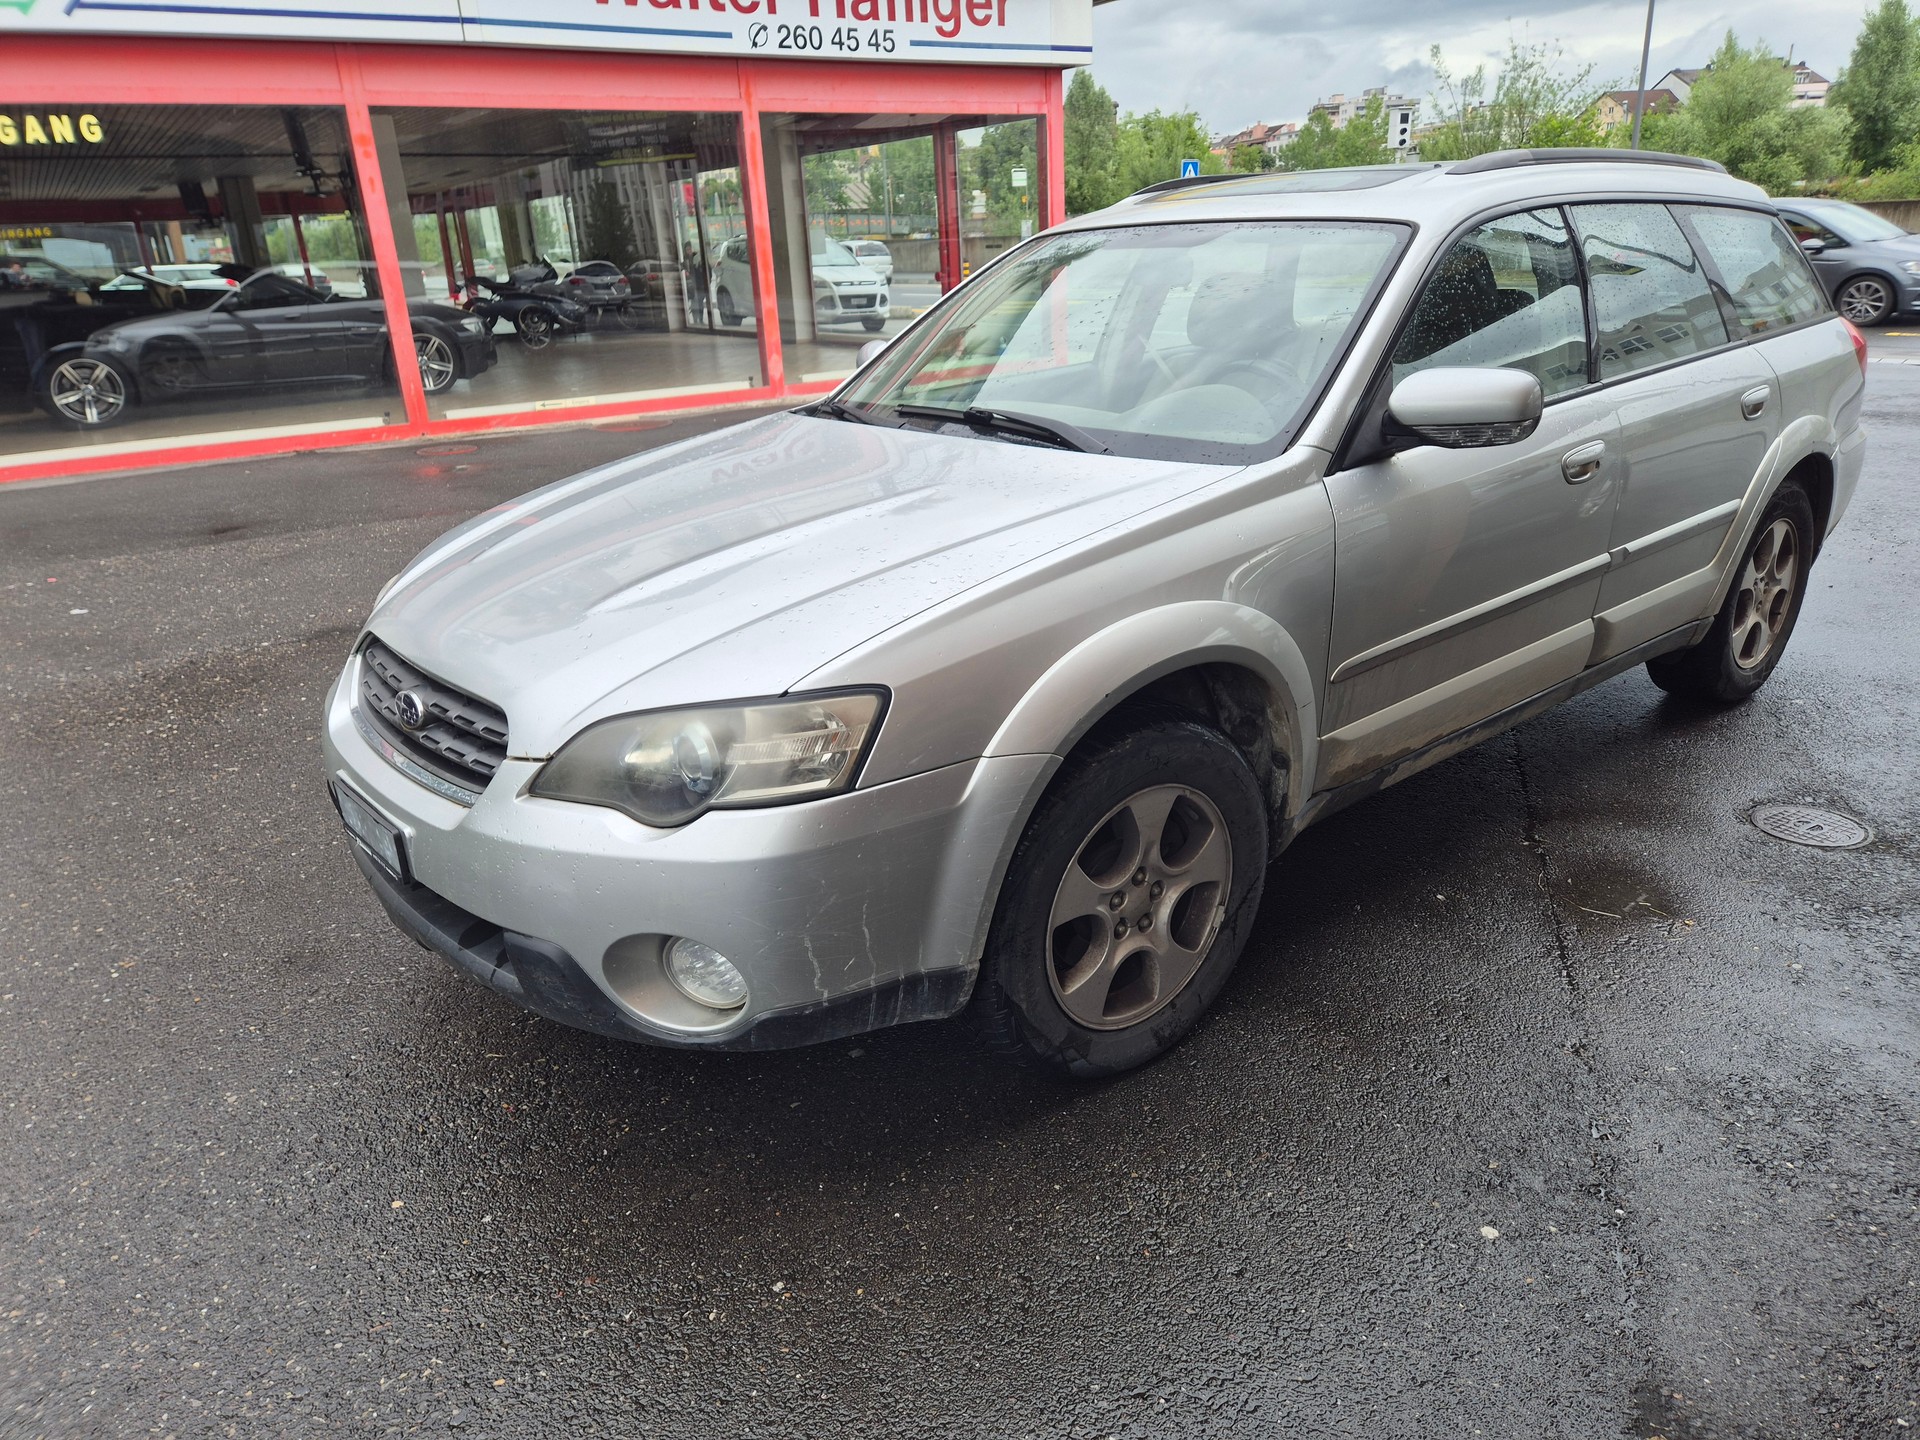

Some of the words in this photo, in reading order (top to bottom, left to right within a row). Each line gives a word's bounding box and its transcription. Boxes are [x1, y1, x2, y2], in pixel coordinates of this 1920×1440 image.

[777, 24, 823, 50] 260
[831, 27, 860, 51] 45
[867, 28, 896, 53] 45
[0, 114, 104, 145] GANG
